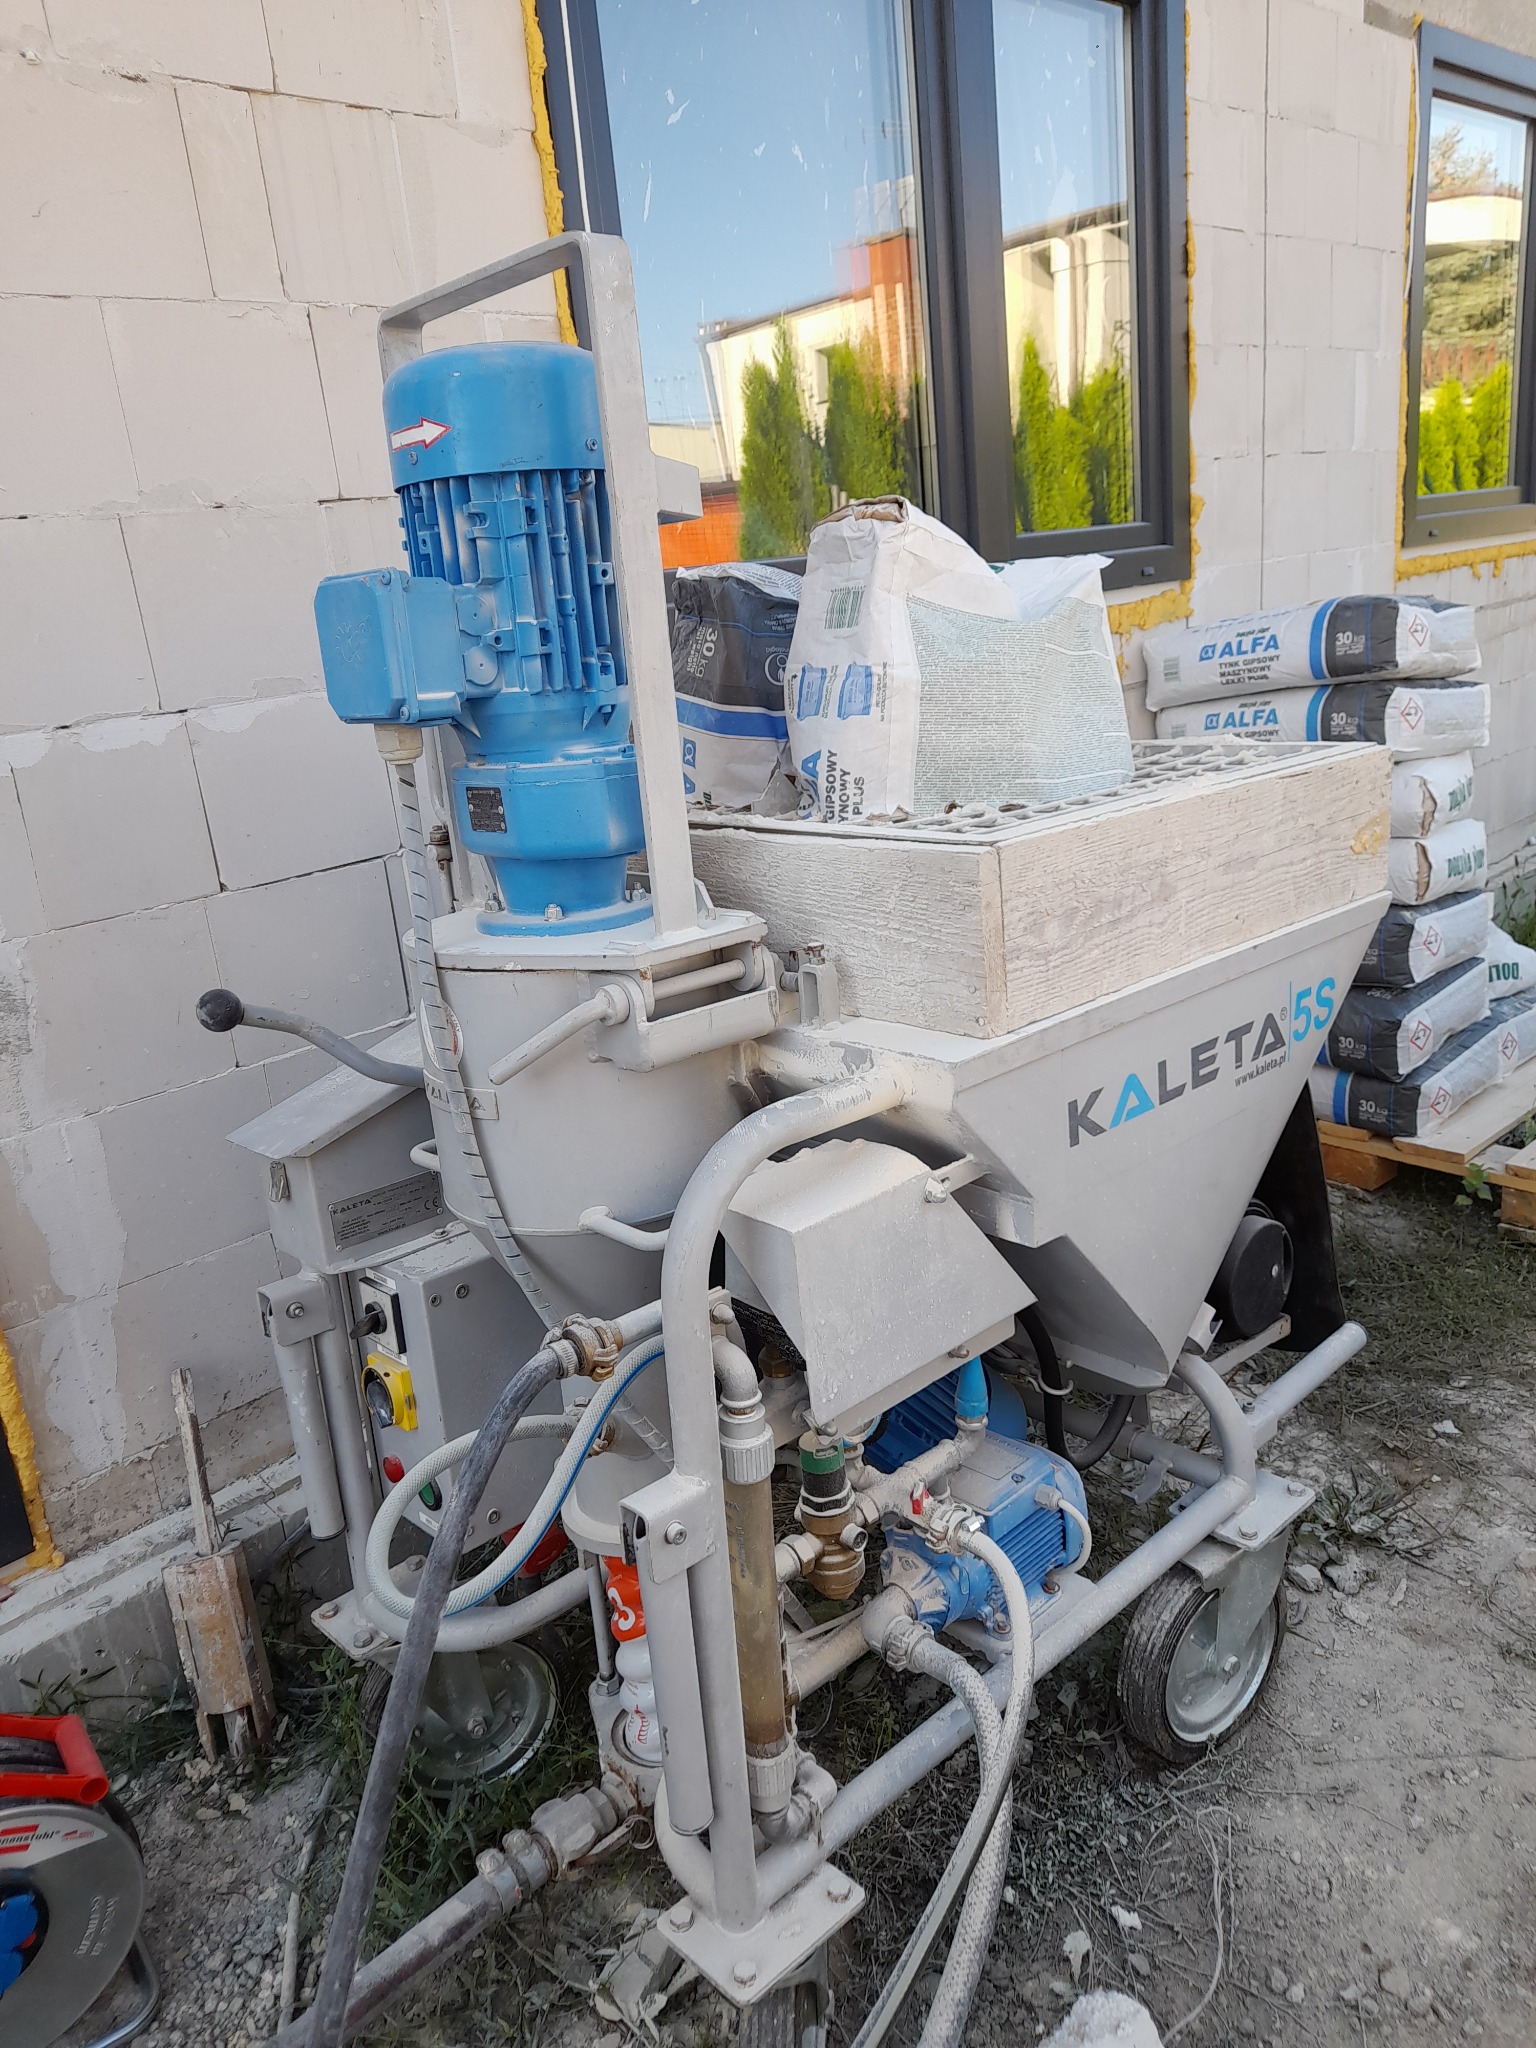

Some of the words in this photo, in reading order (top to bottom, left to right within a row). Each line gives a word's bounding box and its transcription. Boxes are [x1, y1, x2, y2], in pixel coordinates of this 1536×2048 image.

[702, 627, 717, 657] 30
[1218, 633, 1280, 659] ALFA
[1335, 630, 1352, 646] 30
[695, 659, 708, 677] kg
[1218, 660, 1240, 669] TYNK
[1242, 654, 1281, 667] GIPSOWY
[1219, 664, 1272, 678] MASZYNOWY
[1221, 707, 1279, 729] ALFA
[1330, 711, 1347, 726] 30
[1244, 729, 1279, 738] GIPSOWY
[825, 749, 838, 820] GIPSOWY
[852, 776, 865, 815] PLUS
[1337, 1036, 1355, 1049] 30
[1068, 1012, 1287, 1148] KALETA
[1291, 976, 1336, 1042] 5S
[1234, 1050, 1287, 1087] www.kaleta.pl
[1358, 1098, 1376, 1113] 30
[332, 1198, 372, 1216] KALETA
